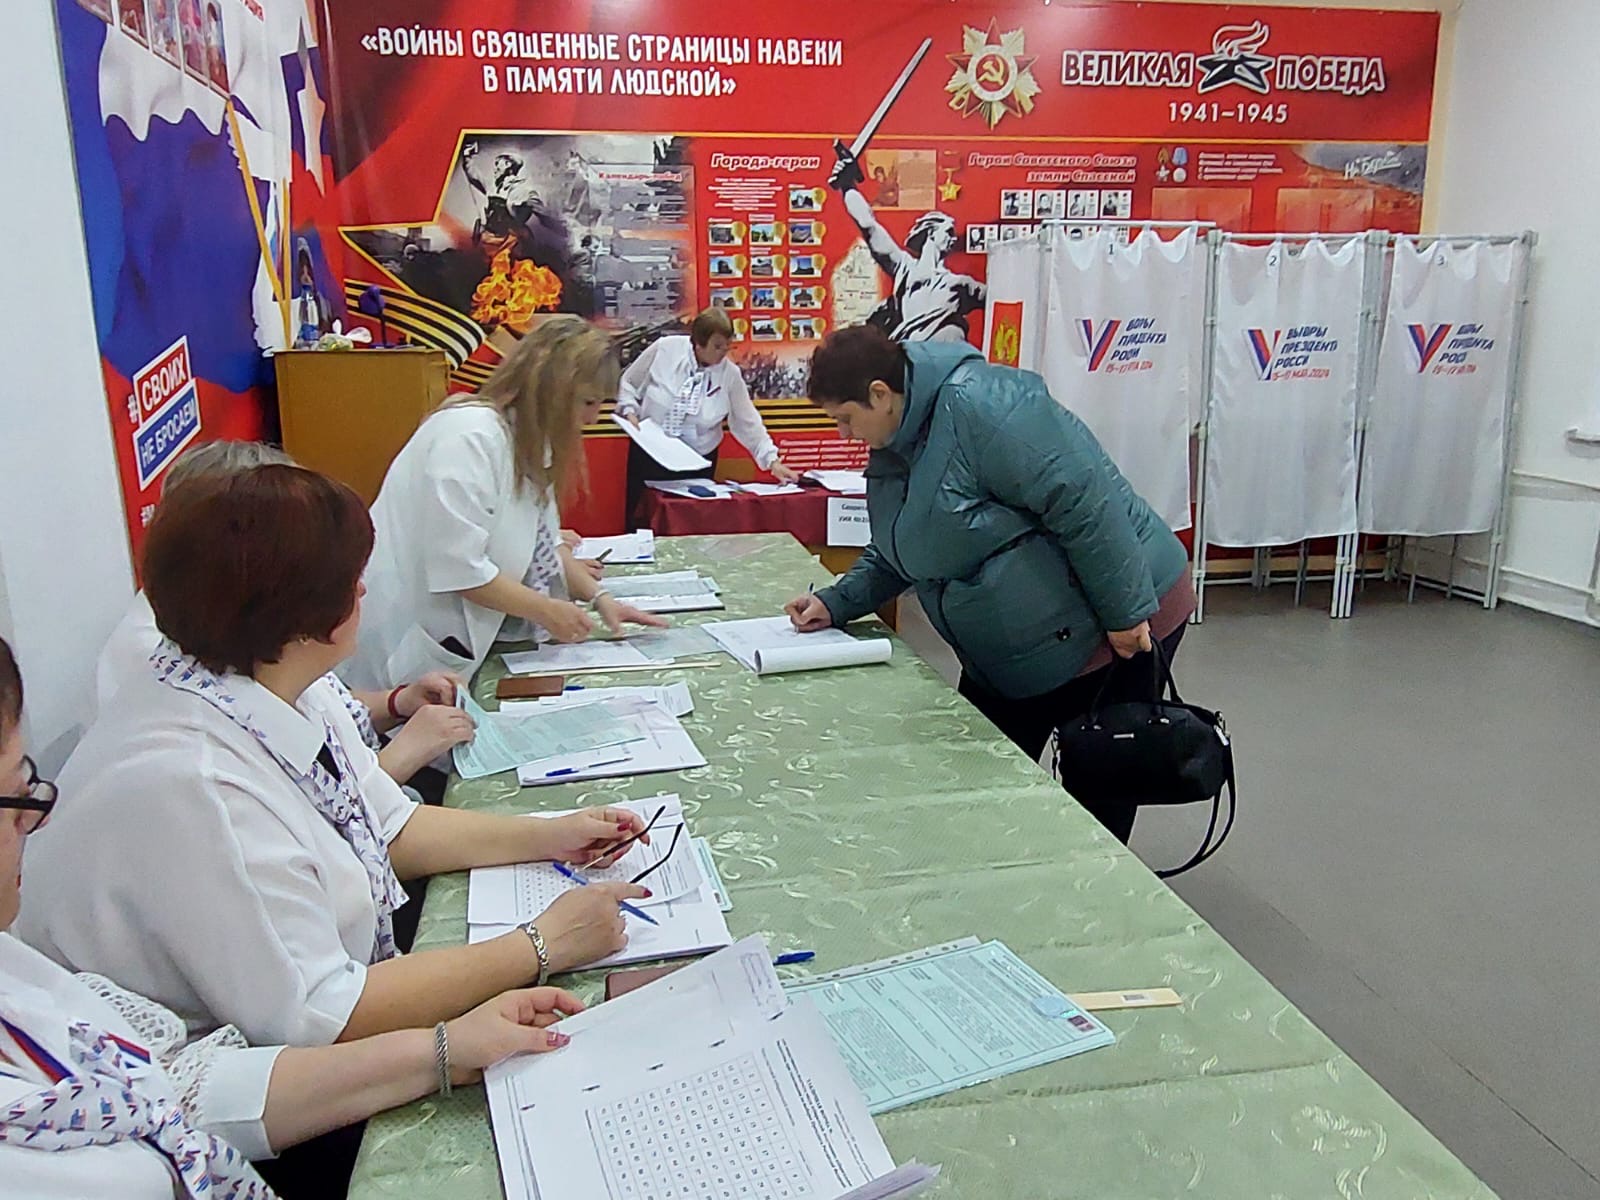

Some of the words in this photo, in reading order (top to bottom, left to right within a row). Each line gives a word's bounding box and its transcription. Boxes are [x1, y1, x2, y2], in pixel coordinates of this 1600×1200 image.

[361, 24, 464, 57] «ВОЙНЫ
[472, 29, 620, 60] СВЯЩЕННЫЕ
[627, 34, 750, 65] СТРАНИЦЫ
[757, 38, 843, 66] НАВЕКИ
[483, 65, 499, 93] В
[506, 66, 603, 94] ПАМЯТИ
[610, 65, 737, 97] ЛЮДСКОЙ»
[1061, 50, 1194, 87] ВЕЛИКАЯ
[1275, 55, 1386, 95] ПОБЕДА
[711, 152, 821, 171] Города-герои
[968, 151, 1012, 169] Герои
[1013, 152, 1092, 168] Советского
[1092, 152, 1137, 168] Союза
[1108, 243, 1114, 255] 1
[1268, 255, 1278, 267] 2
[1437, 254, 1445, 266] 3
[140, 434, 157, 469] НЕ
